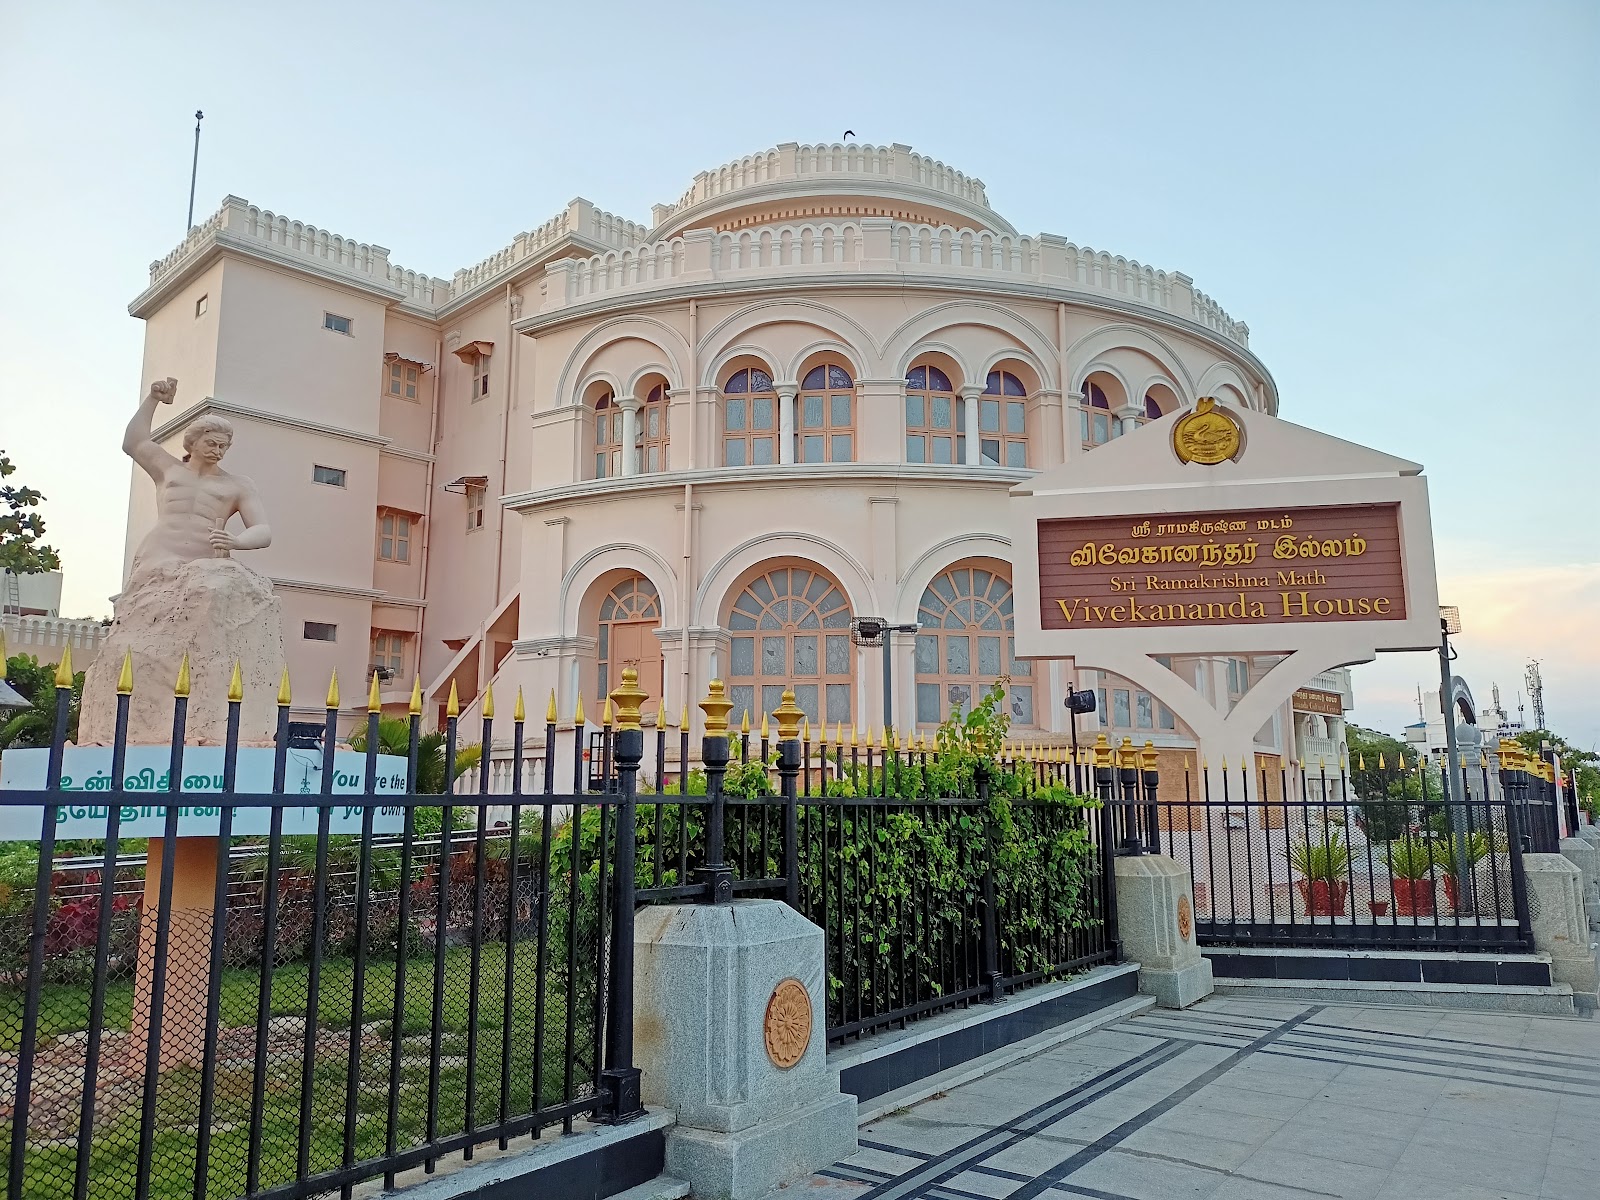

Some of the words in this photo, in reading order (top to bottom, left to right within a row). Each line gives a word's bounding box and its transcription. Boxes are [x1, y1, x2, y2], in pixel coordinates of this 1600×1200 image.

[1156, 519, 1248, 536] ராமகிருஷ்ண
[1257, 514, 1293, 531] மடம்
[1070, 537, 1259, 568] விவேகானந்தர்
[1273, 532, 1367, 560] இல்லம்
[1110, 576, 1137, 592] Sri
[1145, 572, 1270, 590] Ramakrishna
[1277, 569, 1326, 586] Math
[1055, 592, 1268, 622] Vivekananda
[1279, 591, 1391, 617] House
[390, 774, 405, 790] the
